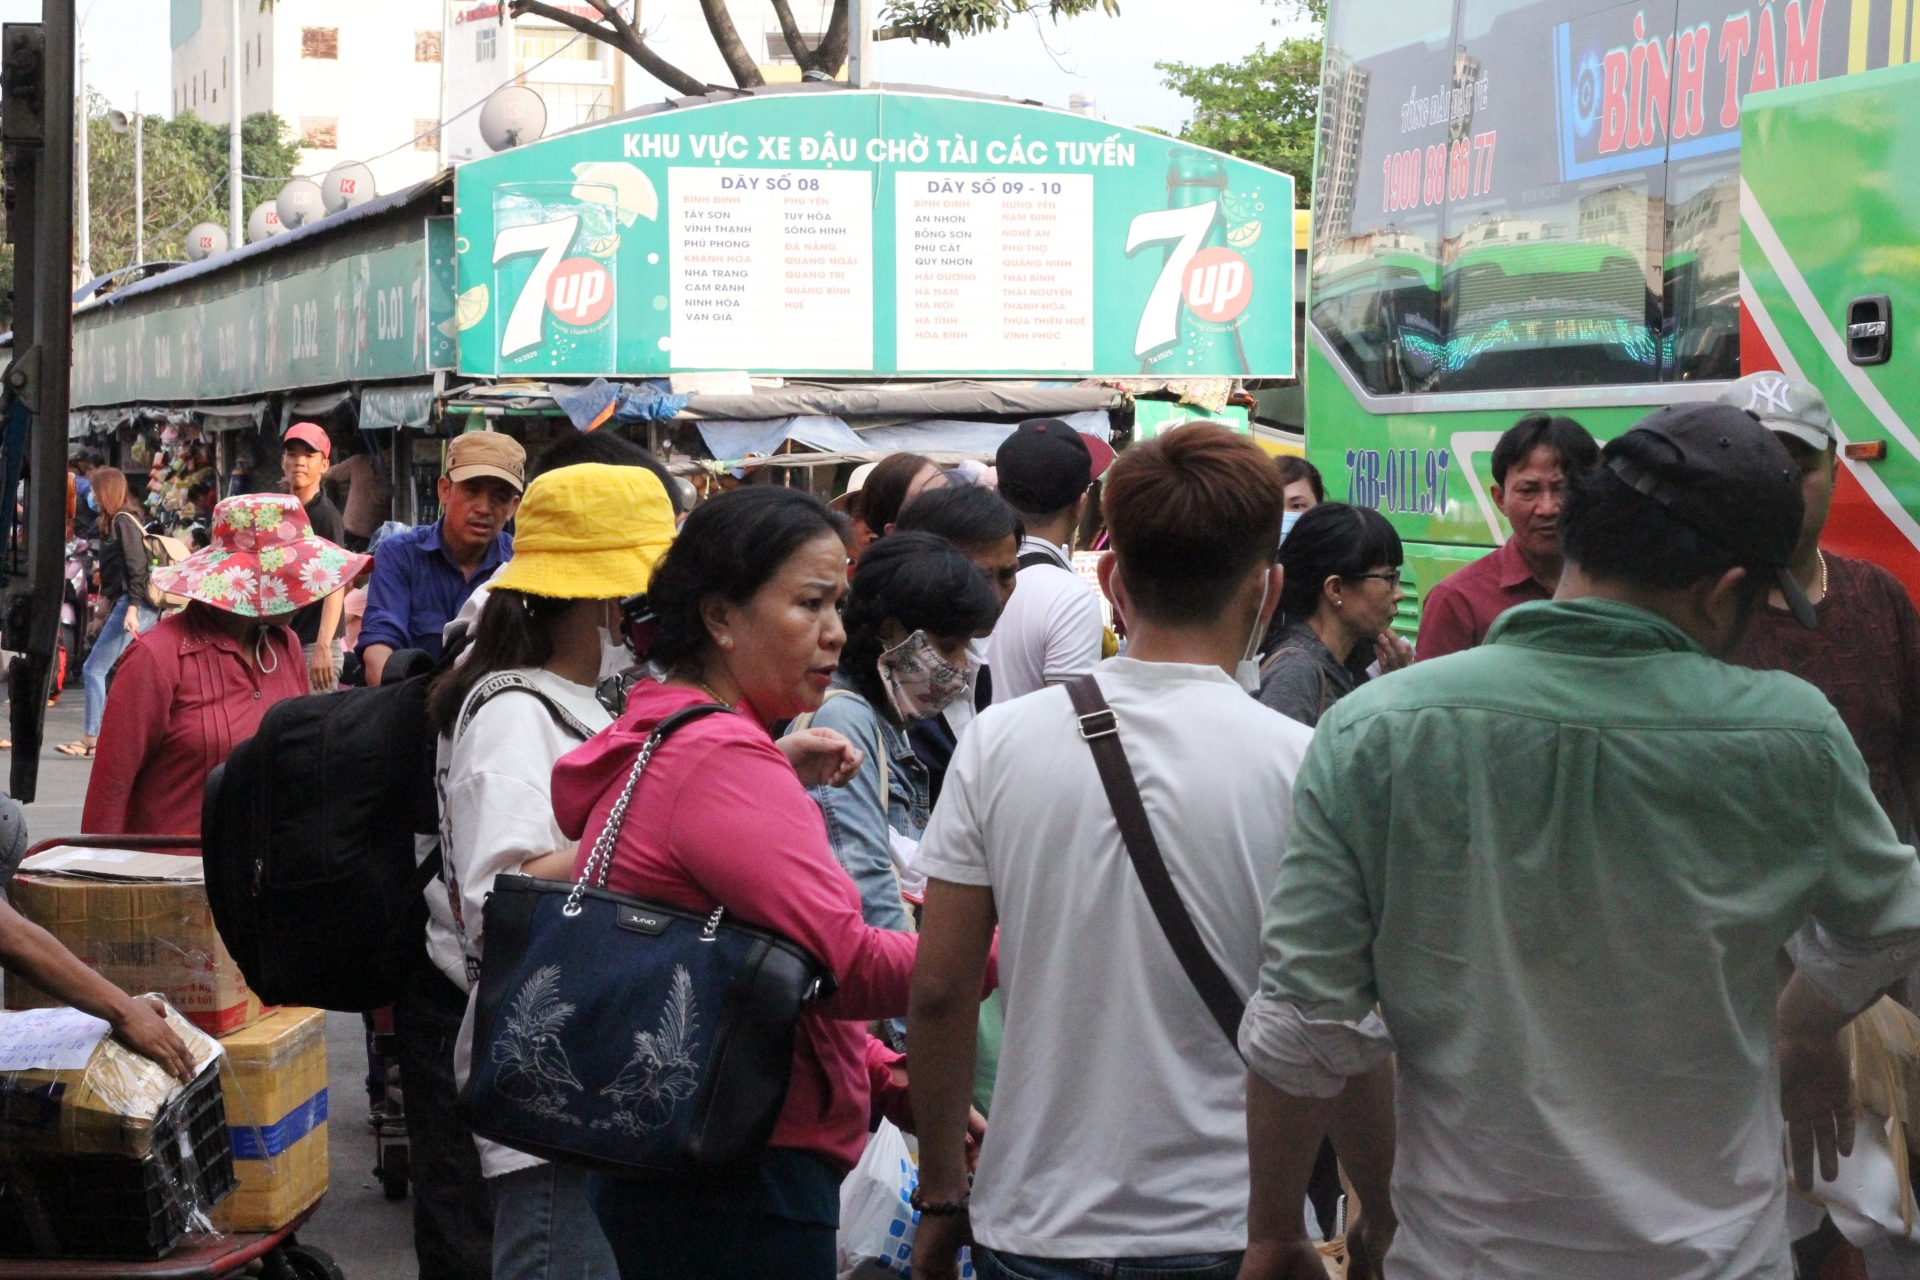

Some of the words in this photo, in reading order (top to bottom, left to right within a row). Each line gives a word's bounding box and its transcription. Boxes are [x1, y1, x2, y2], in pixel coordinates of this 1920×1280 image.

[623, 134, 679, 157] KHU
[689, 133, 749, 165] VỰC
[757, 137, 790, 161] XE
[800, 132, 857, 168] ĐẬU
[866, 130, 929, 162] CHỜ
[937, 134, 977, 164] TÀI
[985, 136, 1048, 164] CÁC
[1056, 133, 1135, 167] TUYẾN
[1382, 148, 1421, 213] 1900
[1423, 143, 1447, 206] 88
[1448, 137, 1470, 201] 66
[1474, 130, 1497, 196] 77
[721, 174, 759, 190] DÃY
[766, 173, 791, 191] SỐ
[798, 178, 819, 191] 08
[927, 178, 965, 193] DÃY
[972, 176, 997, 194] SỐ
[1002, 181, 1023, 194] 09
[1041, 182, 1061, 195] 10
[683, 194, 709, 204] BÌNH
[713, 195, 740, 206] ĐỊNH
[809, 197, 829, 206] YÊN
[914, 198, 939, 208] BÌNH
[943, 200, 970, 210] ĐỊNH
[1002, 201, 1032, 209] HƯNG
[1037, 199, 1056, 209] YÊN
[684, 211, 704, 220] TÂY
[708, 211, 731, 220] SƠN
[784, 212, 803, 221] TUY
[934, 215, 965, 223] NHƠN
[1030, 214, 1056, 223] ĐỊNH
[784, 225, 816, 235] SÔNG
[820, 226, 846, 235] HINH
[950, 230, 972, 238] SƠN
[1002, 228, 1031, 238] NGHỆ
[710, 240, 750, 249] PHONG
[785, 241, 800, 251] ĐÀ
[1027, 244, 1048, 255] THỌ
[684, 252, 723, 263] KHÁNH
[1046, 259, 1072, 267] NINH
[684, 269, 708, 278] NHA
[712, 269, 748, 278] TRANG
[830, 271, 845, 281] TRỊ
[937, 272, 976, 281] DƯƠNG
[1003, 272, 1026, 281] THÁI
[1029, 272, 1054, 282] BÌNH
[685, 283, 711, 292] CAM
[715, 284, 745, 292] RANH
[827, 285, 850, 295] BÌNH
[915, 286, 930, 295] HÀ
[934, 288, 958, 296] NAM
[1003, 287, 1026, 296] THÁI
[1030, 287, 1072, 296] NGUYÊN
[685, 299, 712, 307] NINH
[785, 299, 805, 310] HUẾ
[915, 299, 930, 309] HÀ
[934, 300, 953, 311] NỘI
[1003, 302, 1038, 310] THANH
[378, 286, 403, 340] D.01
[915, 315, 930, 324] HÀ
[1034, 315, 1062, 325] THIÊN
[1066, 314, 1087, 325] HUẾ
[292, 299, 318, 360] D.02
[942, 329, 968, 339] BÌNH
[1032, 329, 1061, 340] PHÚC
